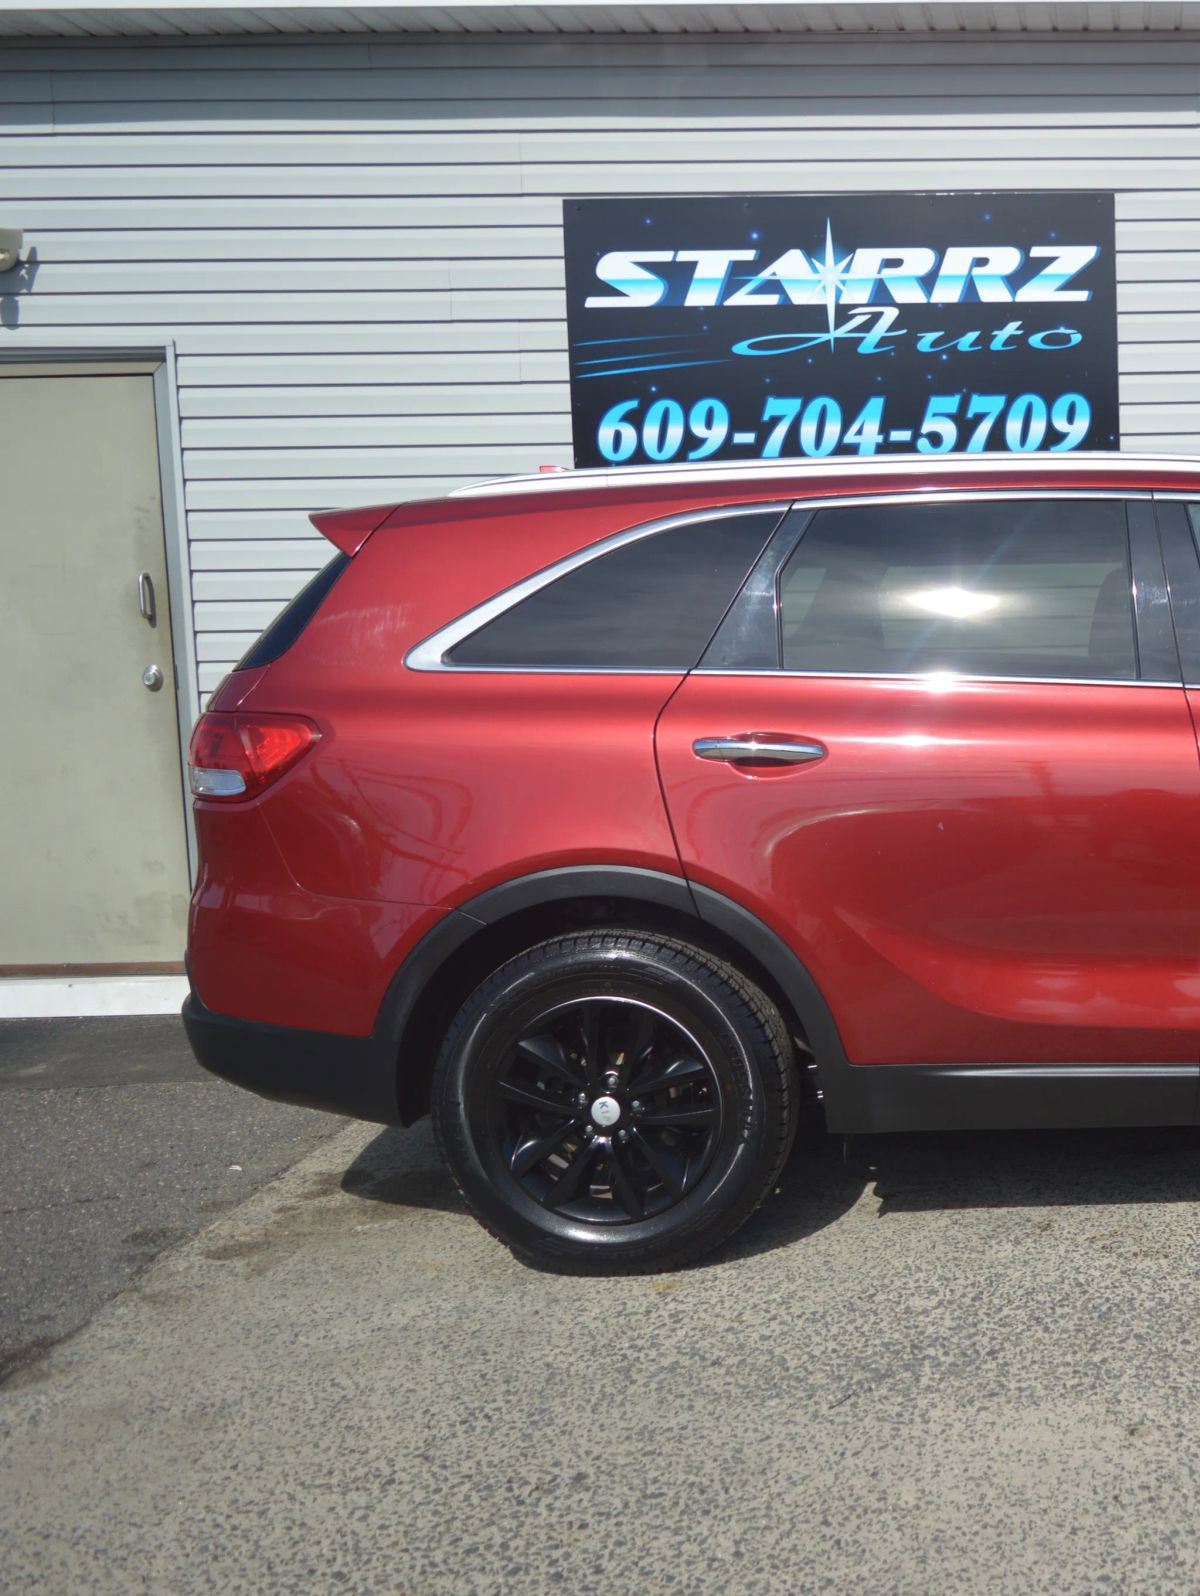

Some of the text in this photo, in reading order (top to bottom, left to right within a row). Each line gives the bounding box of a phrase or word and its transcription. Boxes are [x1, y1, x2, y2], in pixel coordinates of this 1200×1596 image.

[585, 245, 1101, 309] STARRZ
[731, 307, 1083, 357] Auto
[598, 393, 1091, 462] 609-704-5709
